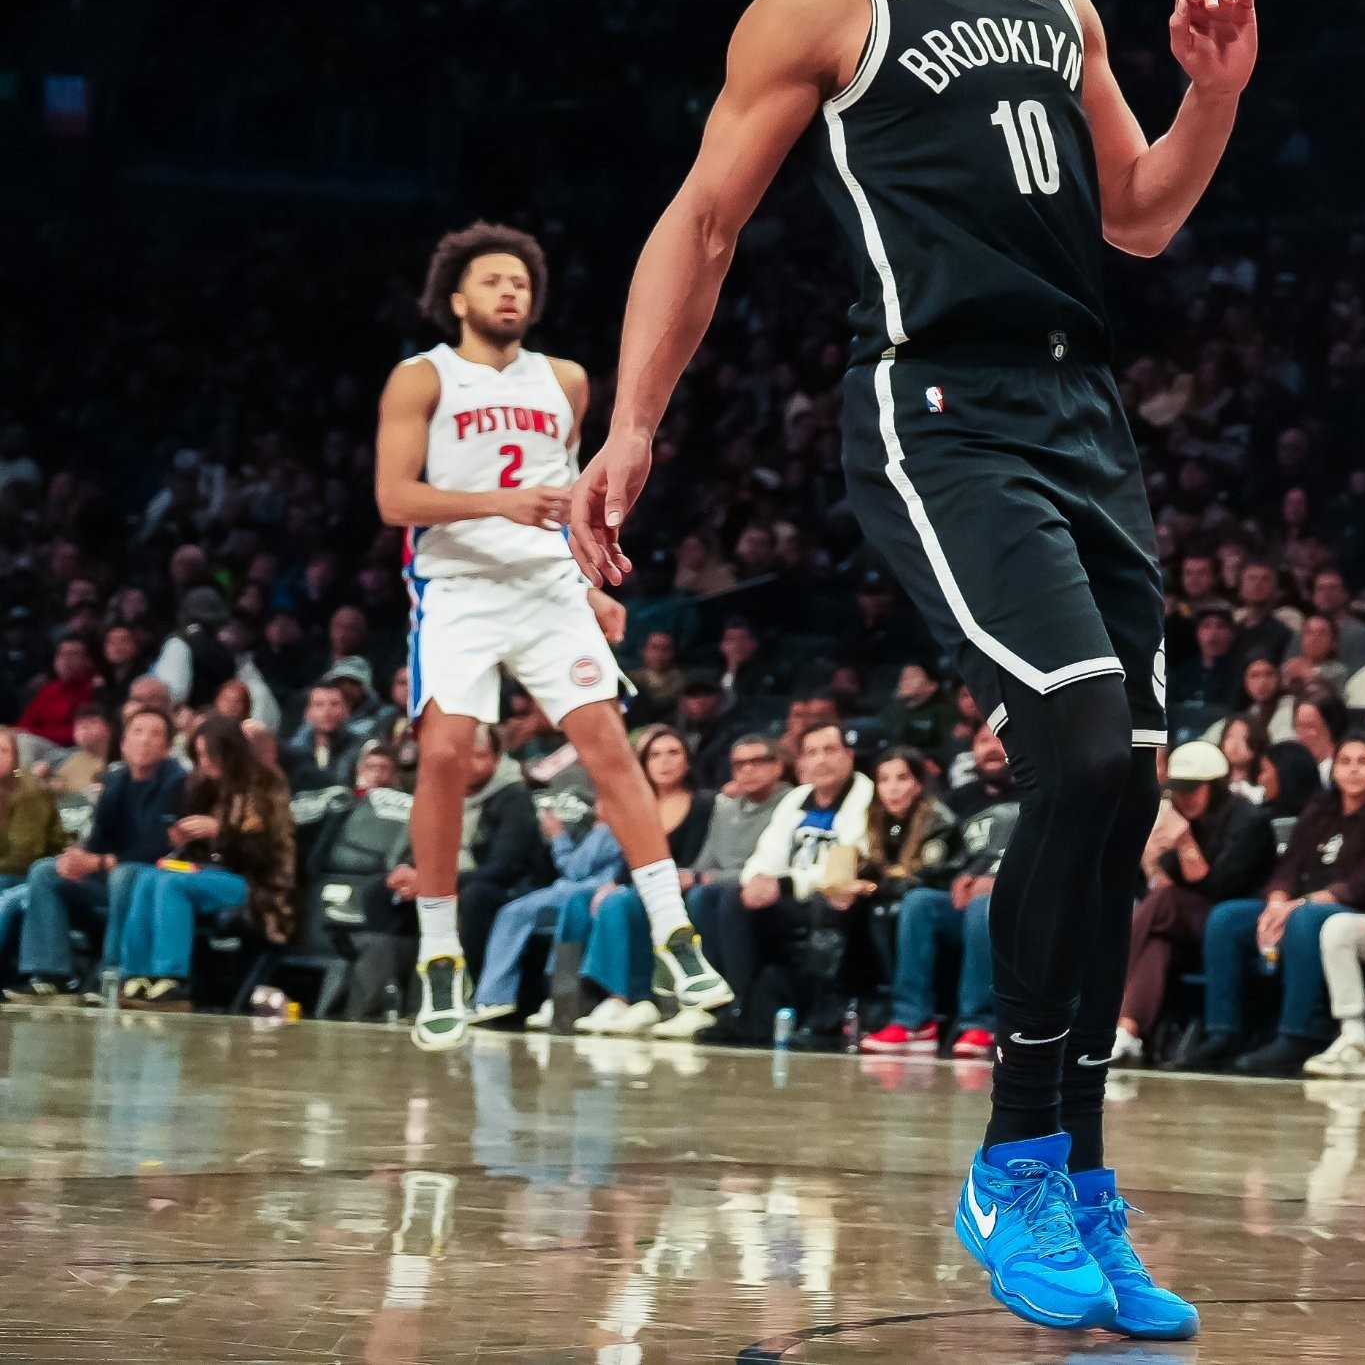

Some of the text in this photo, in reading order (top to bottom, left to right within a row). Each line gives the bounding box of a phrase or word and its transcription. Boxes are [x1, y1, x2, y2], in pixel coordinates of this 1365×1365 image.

[897, 17, 1083, 95] BROOKLYN
[990, 99, 1060, 195] 10
[453, 406, 559, 440] PISTONS
[499, 444, 523, 488] 2
